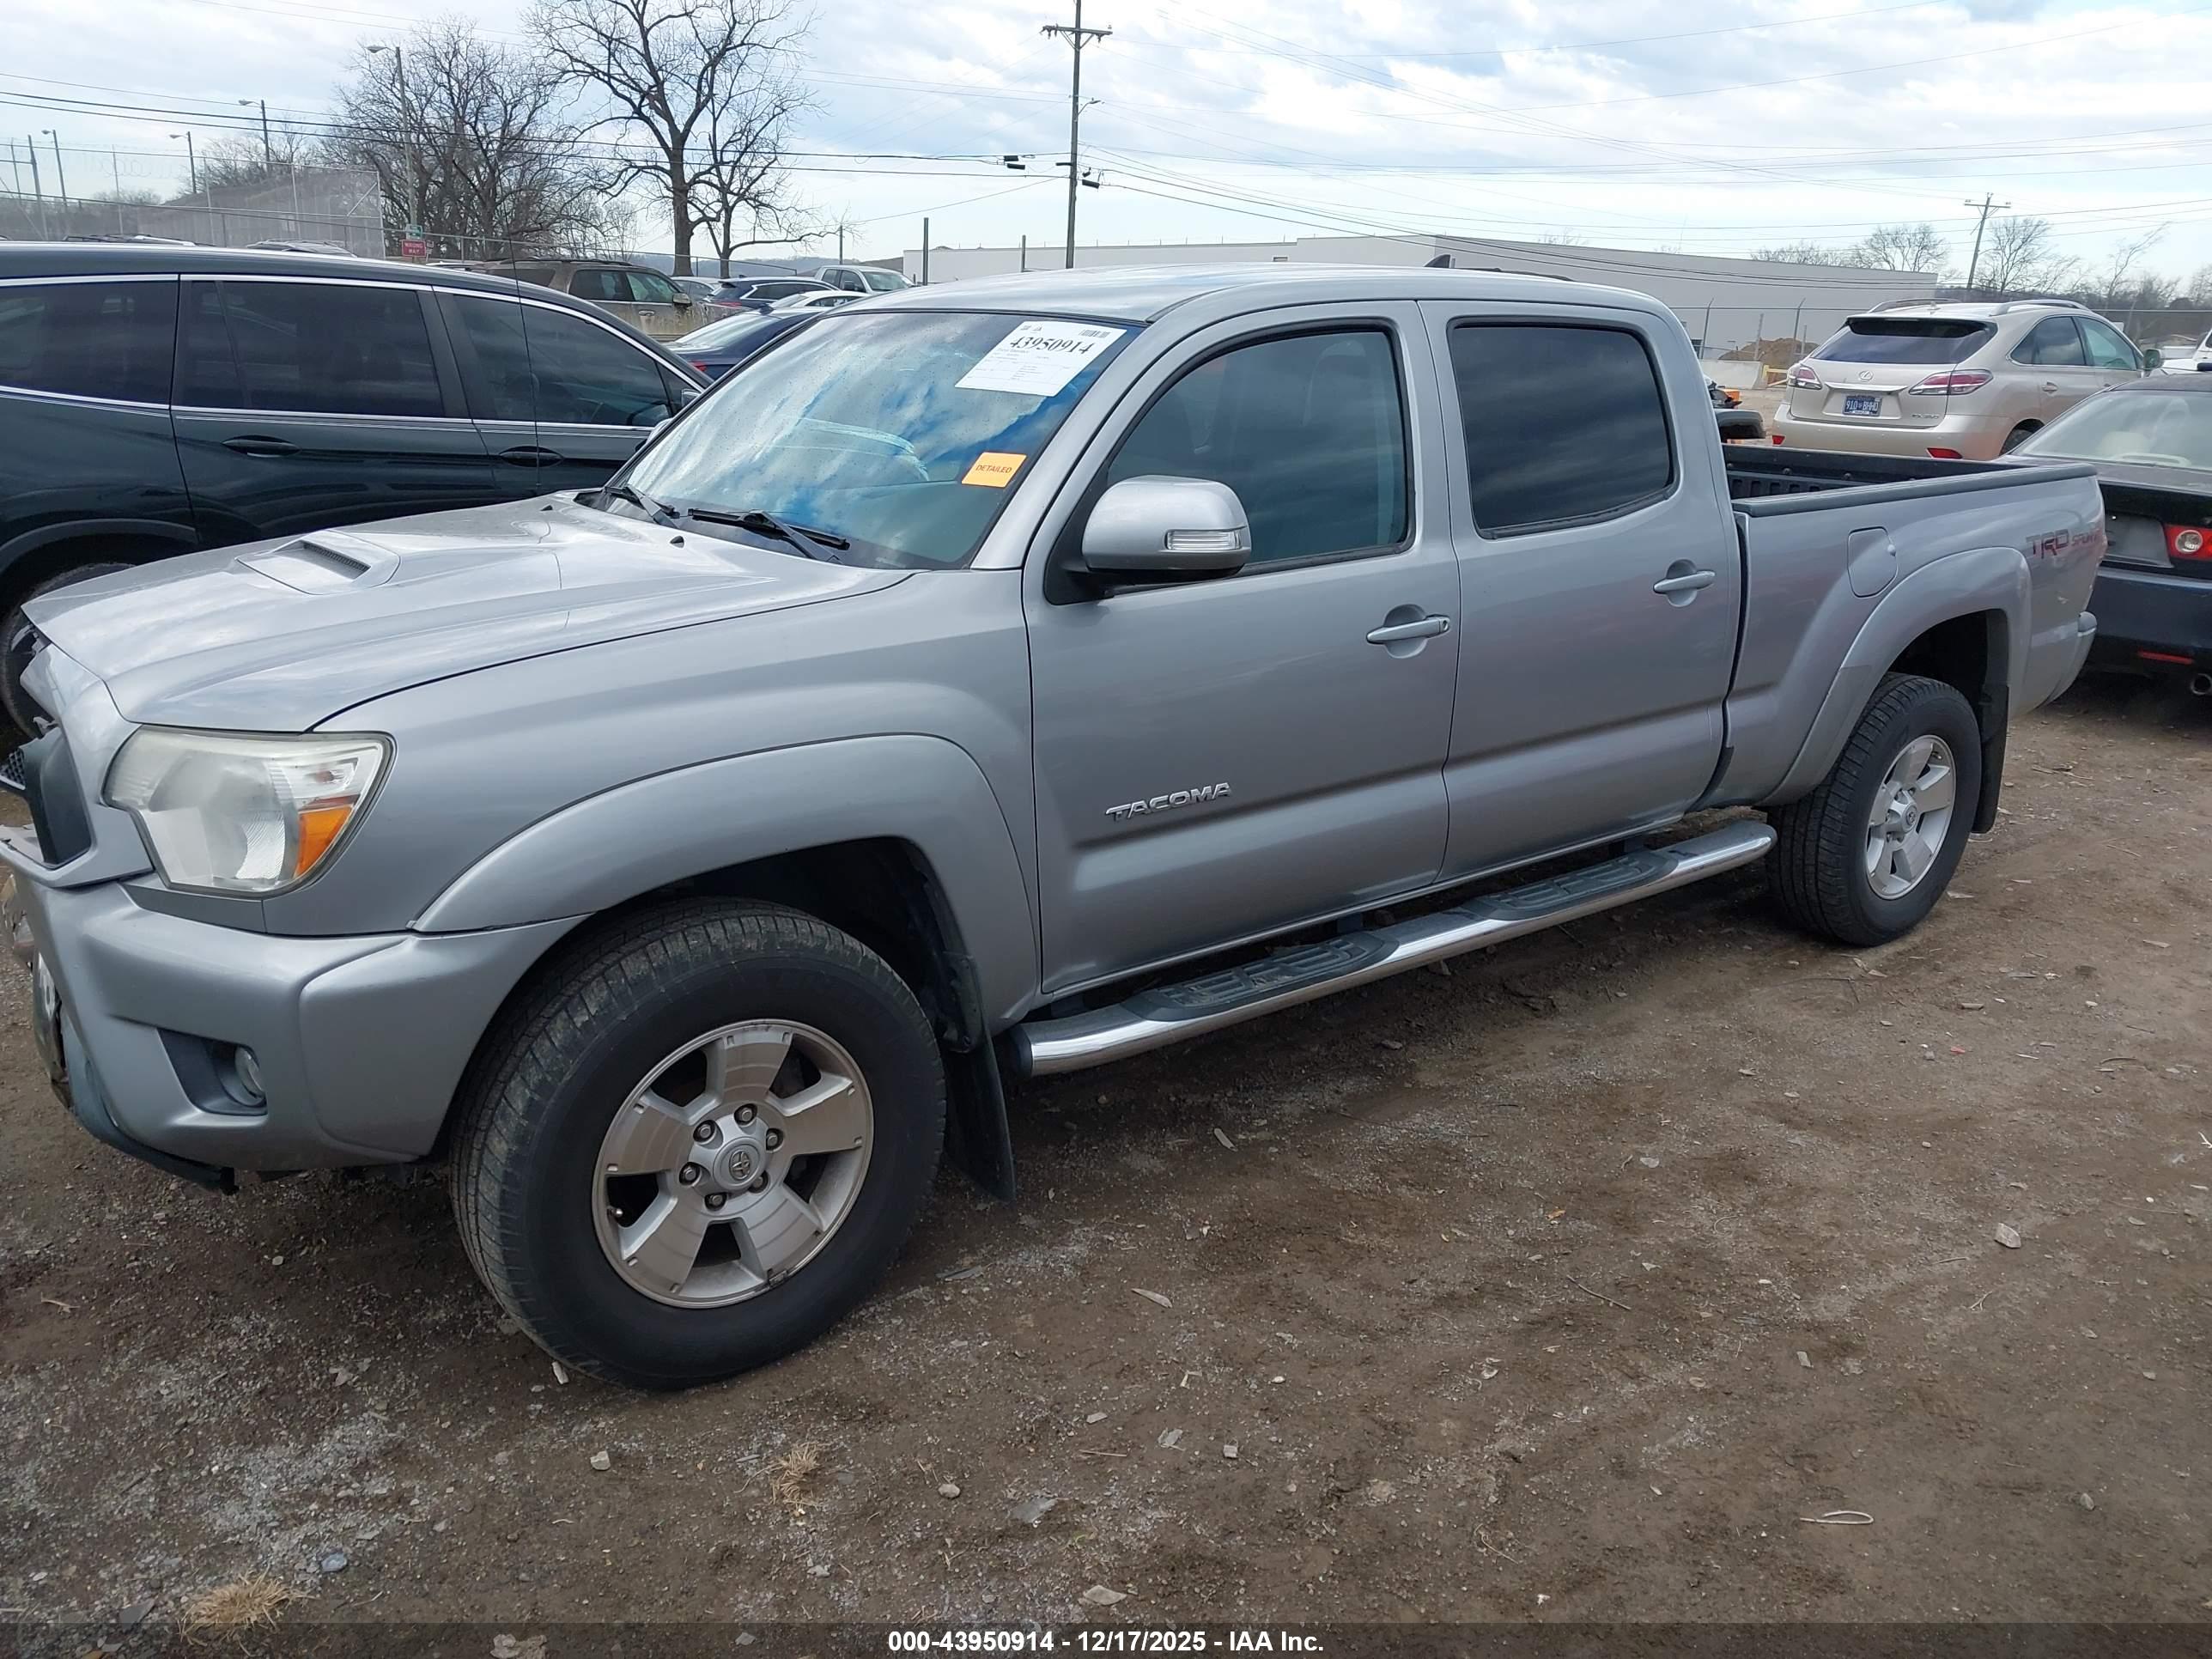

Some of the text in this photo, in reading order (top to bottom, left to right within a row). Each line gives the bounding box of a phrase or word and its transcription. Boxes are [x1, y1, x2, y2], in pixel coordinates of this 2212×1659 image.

[1010, 336, 1095, 355] 43950914
[1846, 400, 1858, 410] 910
[975, 465, 1012, 474] DETAILED
[2026, 529, 2069, 559] TRD
[1105, 782, 1231, 822] TACOMA
